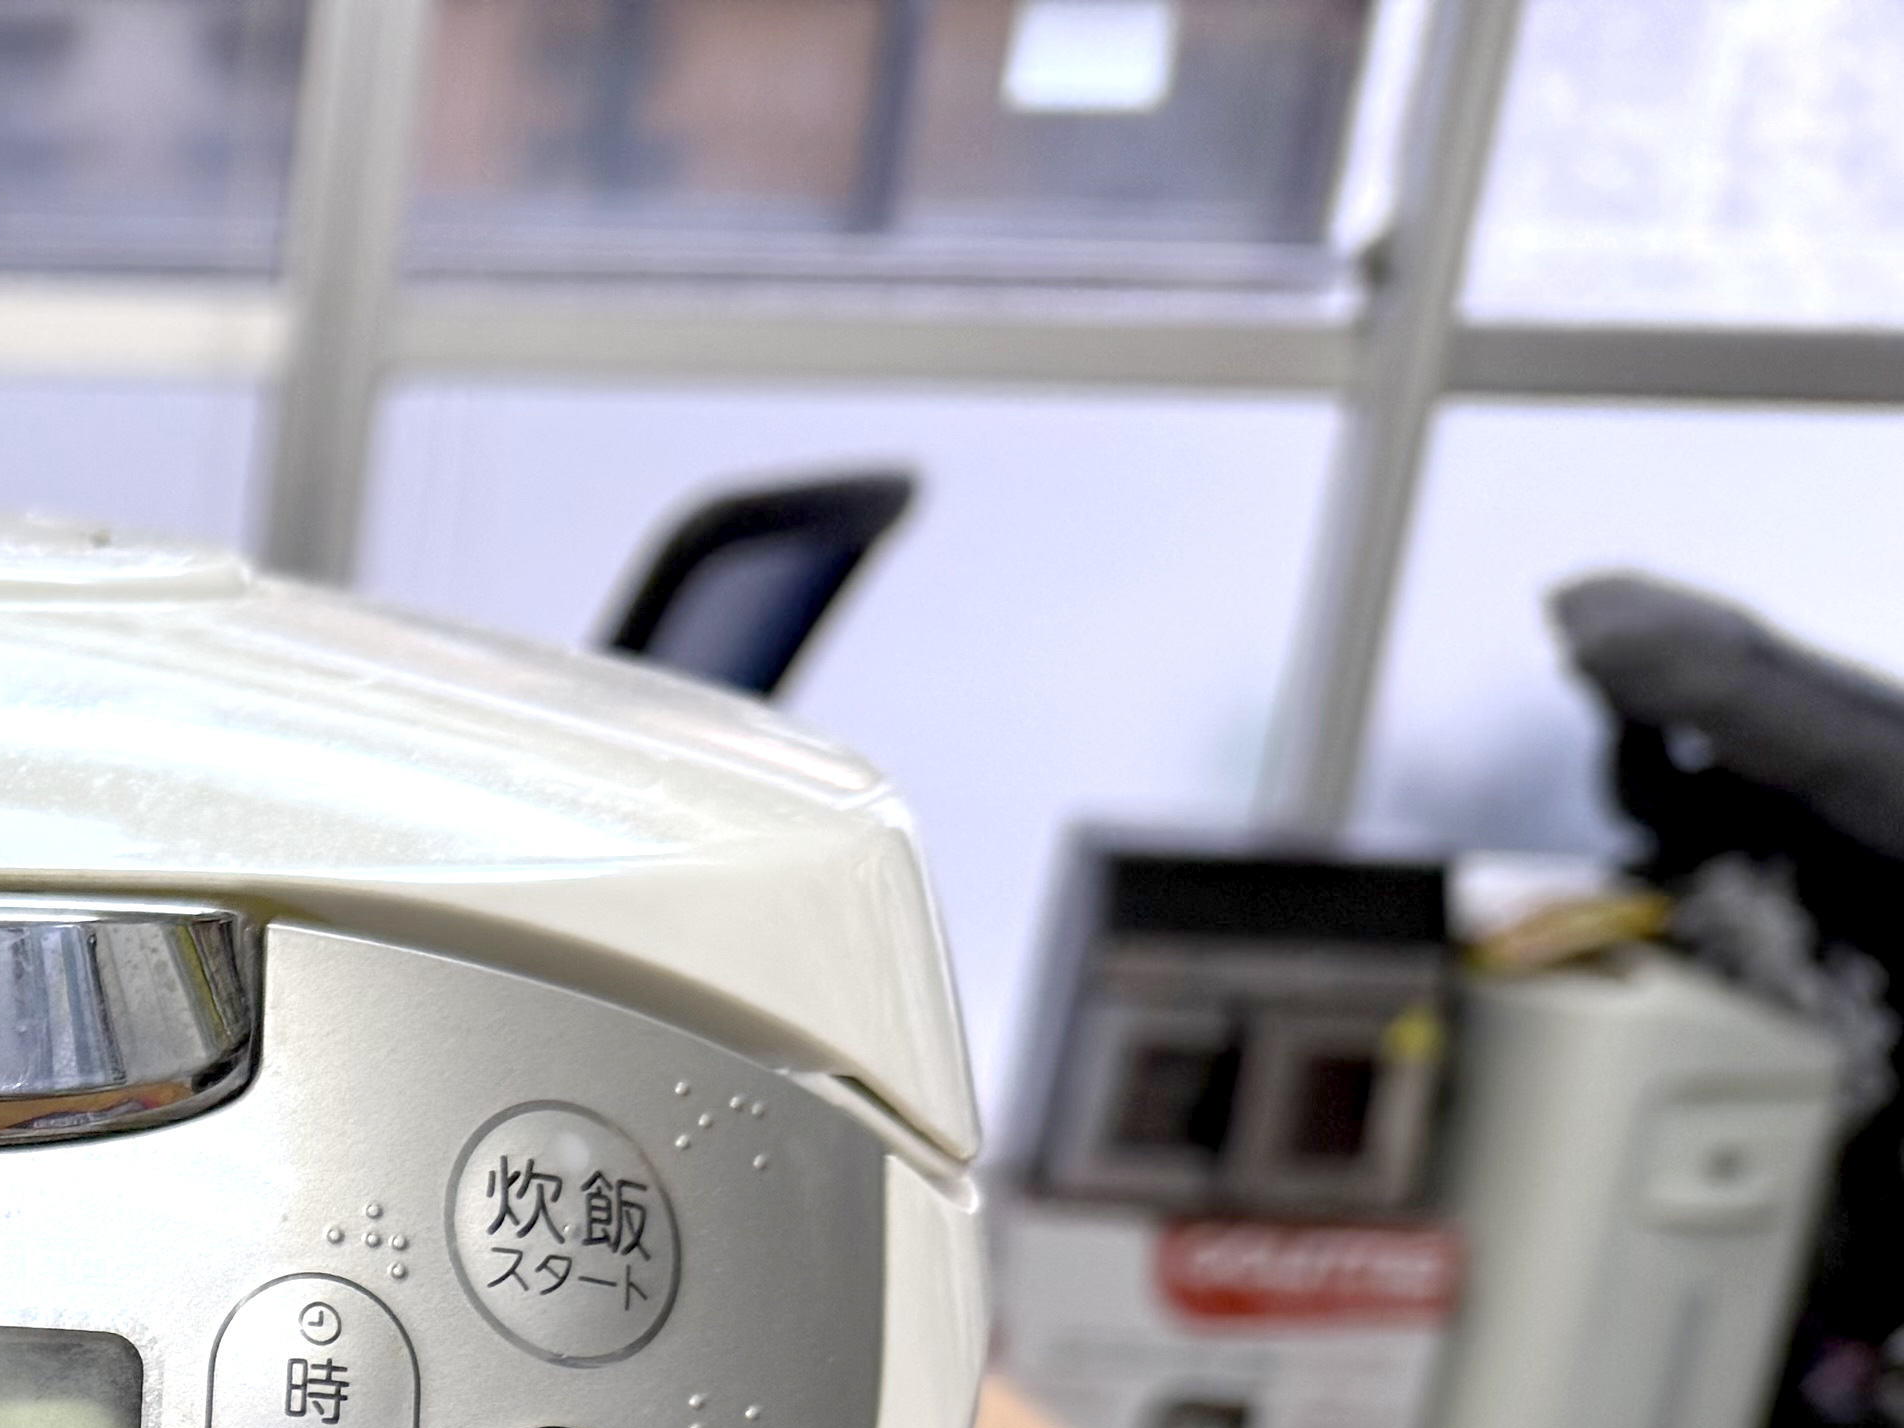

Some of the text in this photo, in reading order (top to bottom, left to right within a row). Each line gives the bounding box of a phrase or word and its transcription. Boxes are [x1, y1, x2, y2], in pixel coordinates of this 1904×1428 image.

[487, 1155, 651, 1262] 炊飯
[488, 1246, 648, 1312] スタート
[284, 1357, 350, 1425] 時
